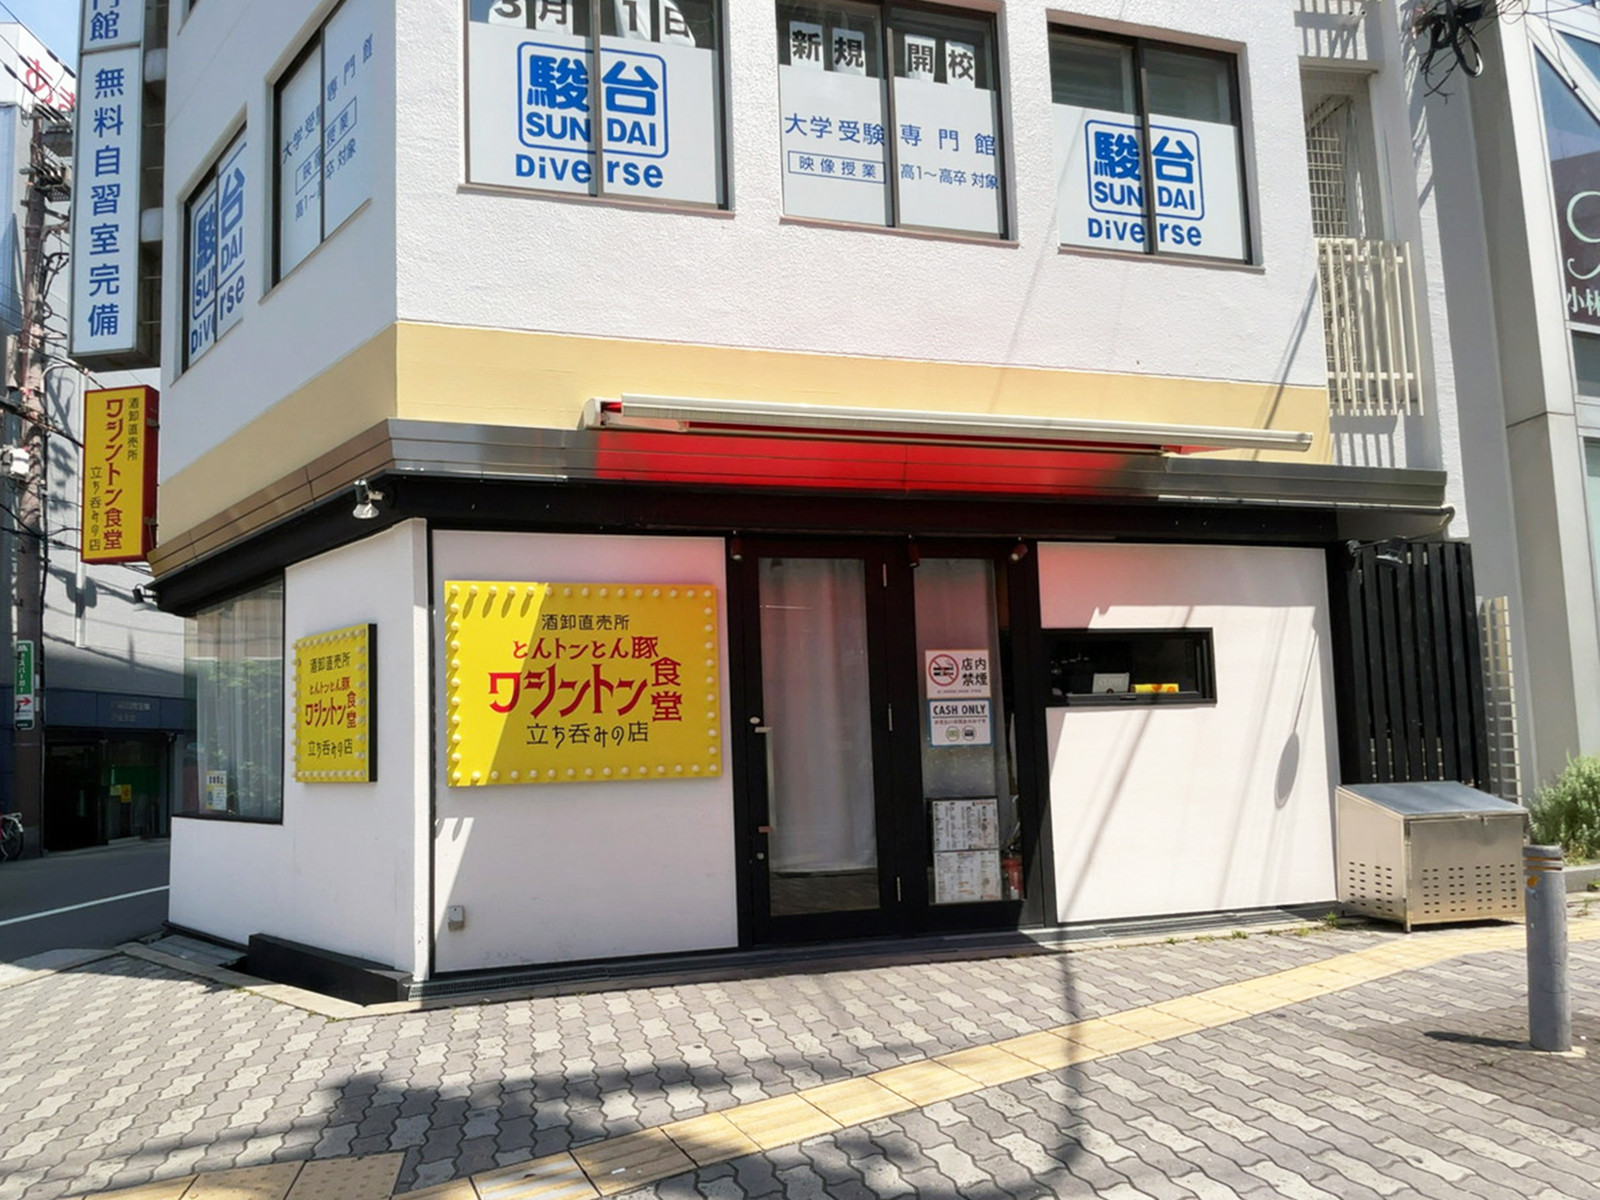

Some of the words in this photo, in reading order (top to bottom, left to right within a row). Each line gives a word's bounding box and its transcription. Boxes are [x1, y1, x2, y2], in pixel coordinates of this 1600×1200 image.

[527, 54, 659, 116] 駿台
[799, 156, 877, 179] 映像授業
[1094, 131, 1195, 184] 駿台
[87, 67, 125, 338] 無料自習室完備
[127, 397, 139, 461] 酒卸直売所
[103, 398, 124, 550] ワシントン食堂
[89, 466, 102, 551] 立ち呑みの店
[541, 614, 630, 631] 酒卸直売所
[512, 636, 659, 660] とんトンとん豚
[309, 652, 351, 674] 酒卸直売所
[961, 657, 987, 671] 店内
[309, 676, 351, 695] とんトンとん豚
[962, 672, 988, 686] 禁煙
[933, 705, 958, 715] CASH
[961, 704, 986, 714] ONLY
[526, 721, 649, 749] 立ち呑みの店
[308, 738, 353, 759] 立ち呑みの店
